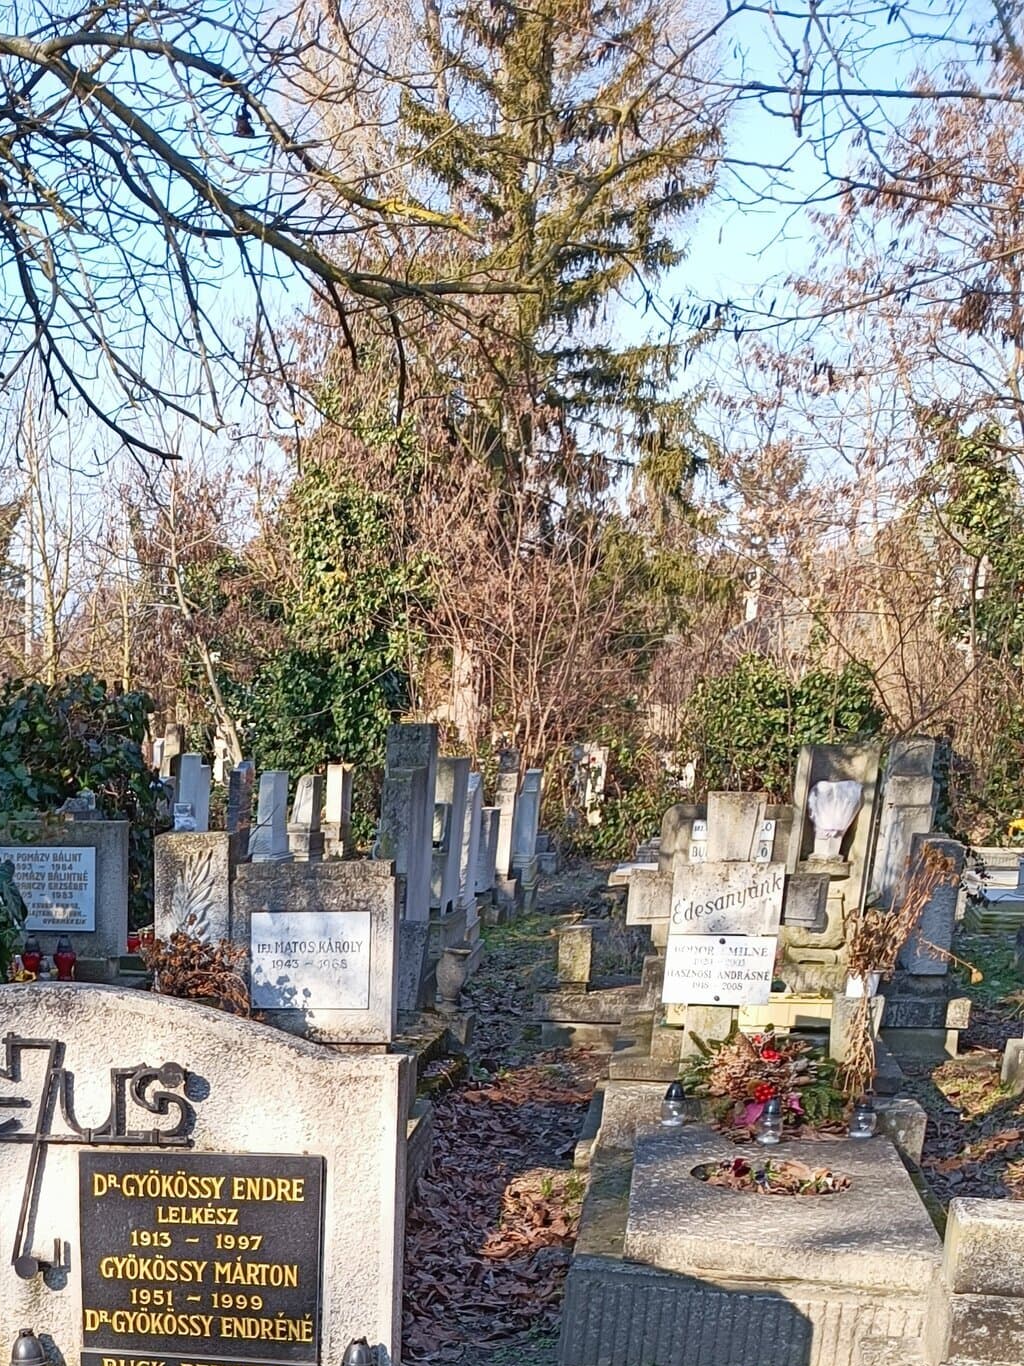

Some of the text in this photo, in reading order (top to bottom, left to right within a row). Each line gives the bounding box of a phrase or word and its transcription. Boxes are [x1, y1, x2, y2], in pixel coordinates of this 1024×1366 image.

[52, 850, 82, 862] BÁLINT
[15, 869, 46, 881] OMÁZY
[275, 941, 316, 954] MATOS
[318, 937, 364, 953] KÁROLY
[272, 959, 299, 969] 1943
[717, 968, 770, 982] ANDRÁSNÉ
[122, 1169, 226, 1200] GYÖKÖSSY
[232, 1176, 305, 1202] ENDRE
[156, 1203, 239, 1226] LELKÉSZ
[130, 1230, 172, 1248] 1913
[215, 1233, 264, 1251] 1997
[100, 1254, 299, 1288] GYÖKÖSSY MÁRTON
[130, 1287, 173, 1306] 1951
[211, 1292, 264, 1311] 1999
[112, 1307, 214, 1338] GYÖKÖSSY
[219, 1311, 314, 1343] ENDRÉNÉ
